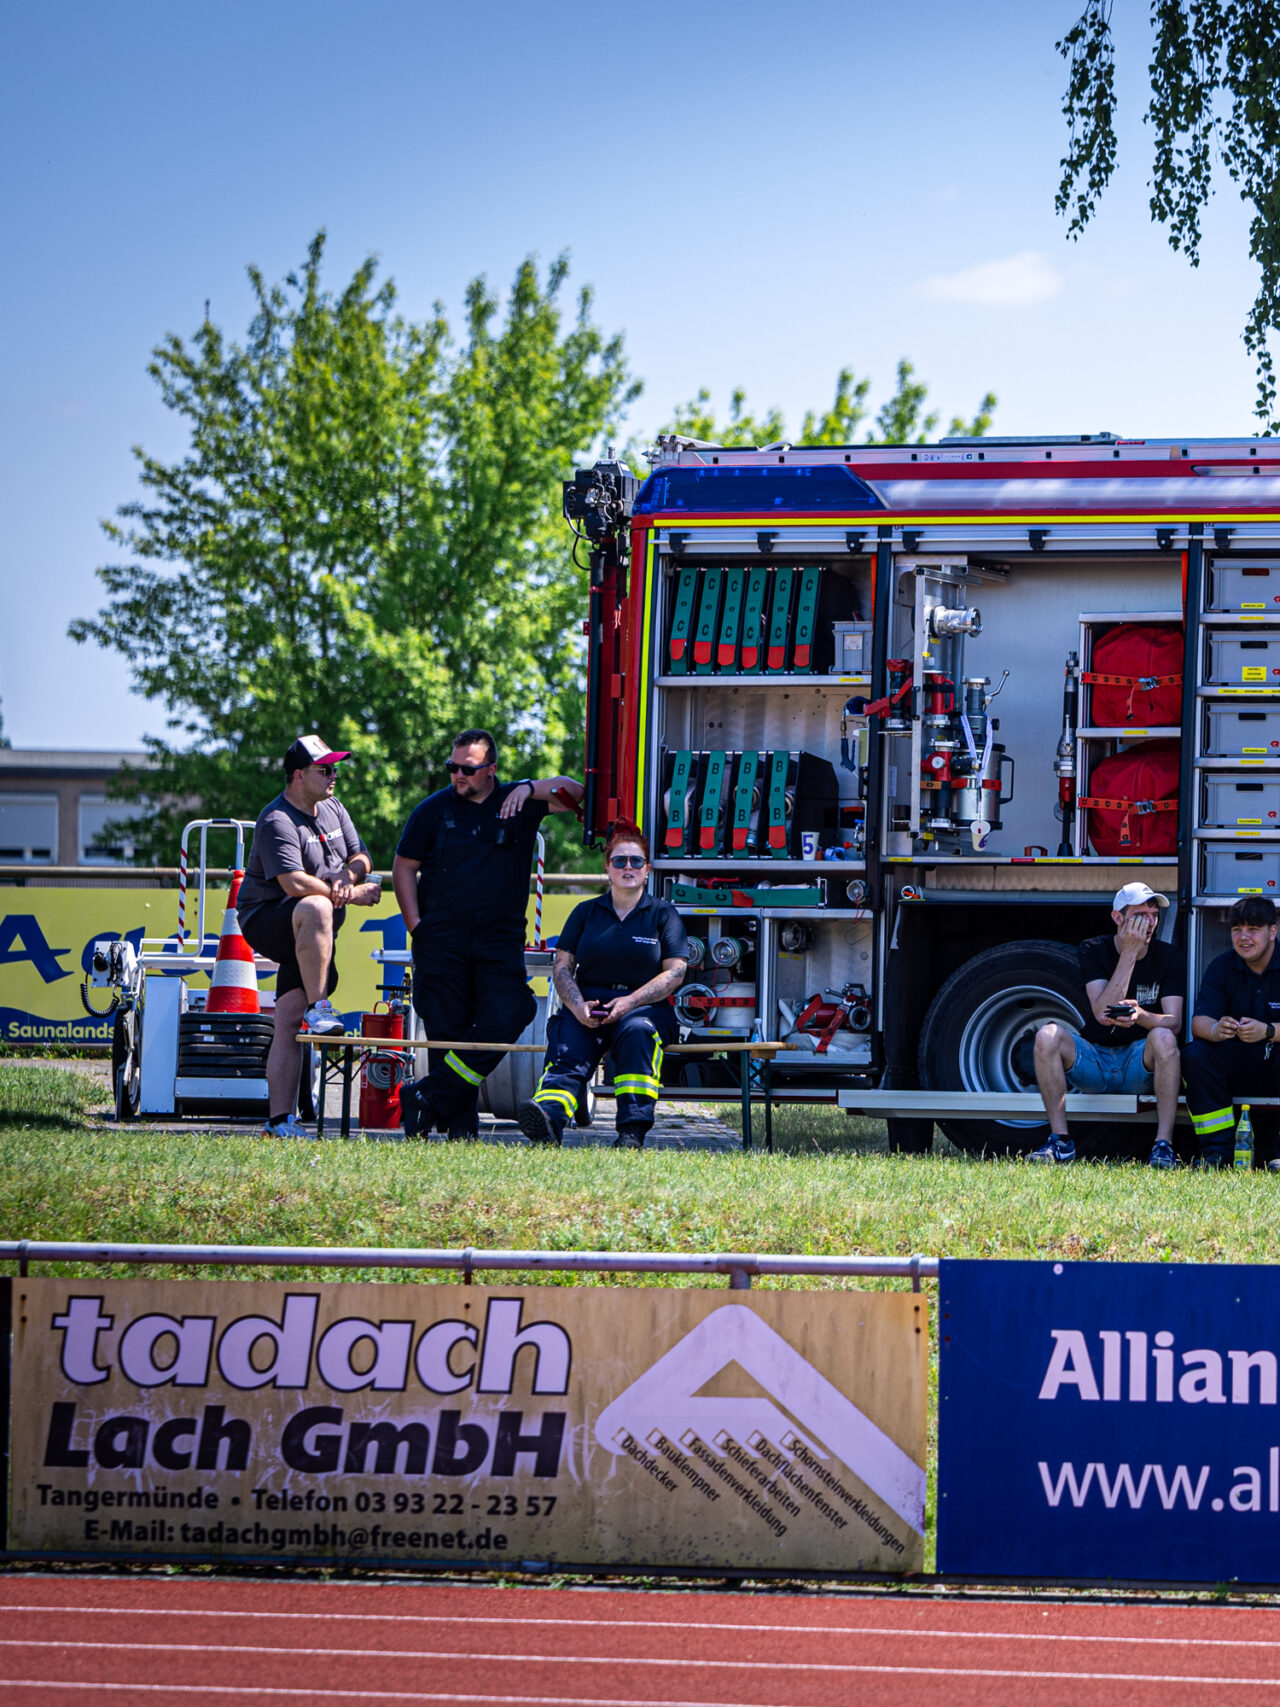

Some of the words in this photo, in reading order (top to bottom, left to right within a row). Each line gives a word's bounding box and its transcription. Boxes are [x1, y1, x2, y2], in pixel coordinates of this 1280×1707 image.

[678, 764, 685, 775] B
[712, 763, 719, 774] B
[744, 763, 751, 773] B
[776, 761, 783, 772] B
[672, 811, 679, 822] B
[706, 808, 713, 820] B
[738, 810, 745, 821] B
[774, 808, 781, 819] B
[803, 834, 814, 854] 5
[51, 1293, 572, 1395] tadach
[43, 1402, 251, 1470] Lach
[281, 1406, 566, 1478] GmbH
[621, 1434, 679, 1492] Dachdecker
[655, 1436, 721, 1502] Bauklempner
[722, 1438, 801, 1517] Schieferarbeiten
[689, 1437, 788, 1537] Fassadenverkleidung
[755, 1438, 848, 1529] Dachflächenfenster
[789, 1439, 905, 1554] Schornsteinverkleidungen
[36, 1484, 219, 1512] Tangermünde
[251, 1488, 348, 1512] Telefon
[355, 1492, 386, 1514] 03
[393, 1492, 425, 1514] 93
[432, 1493, 464, 1515] 22
[486, 1494, 518, 1516] 23
[525, 1496, 558, 1517] 57
[84, 1519, 174, 1542] E-Mail:
[180, 1521, 508, 1551] tadachgmbh@freenet.de
